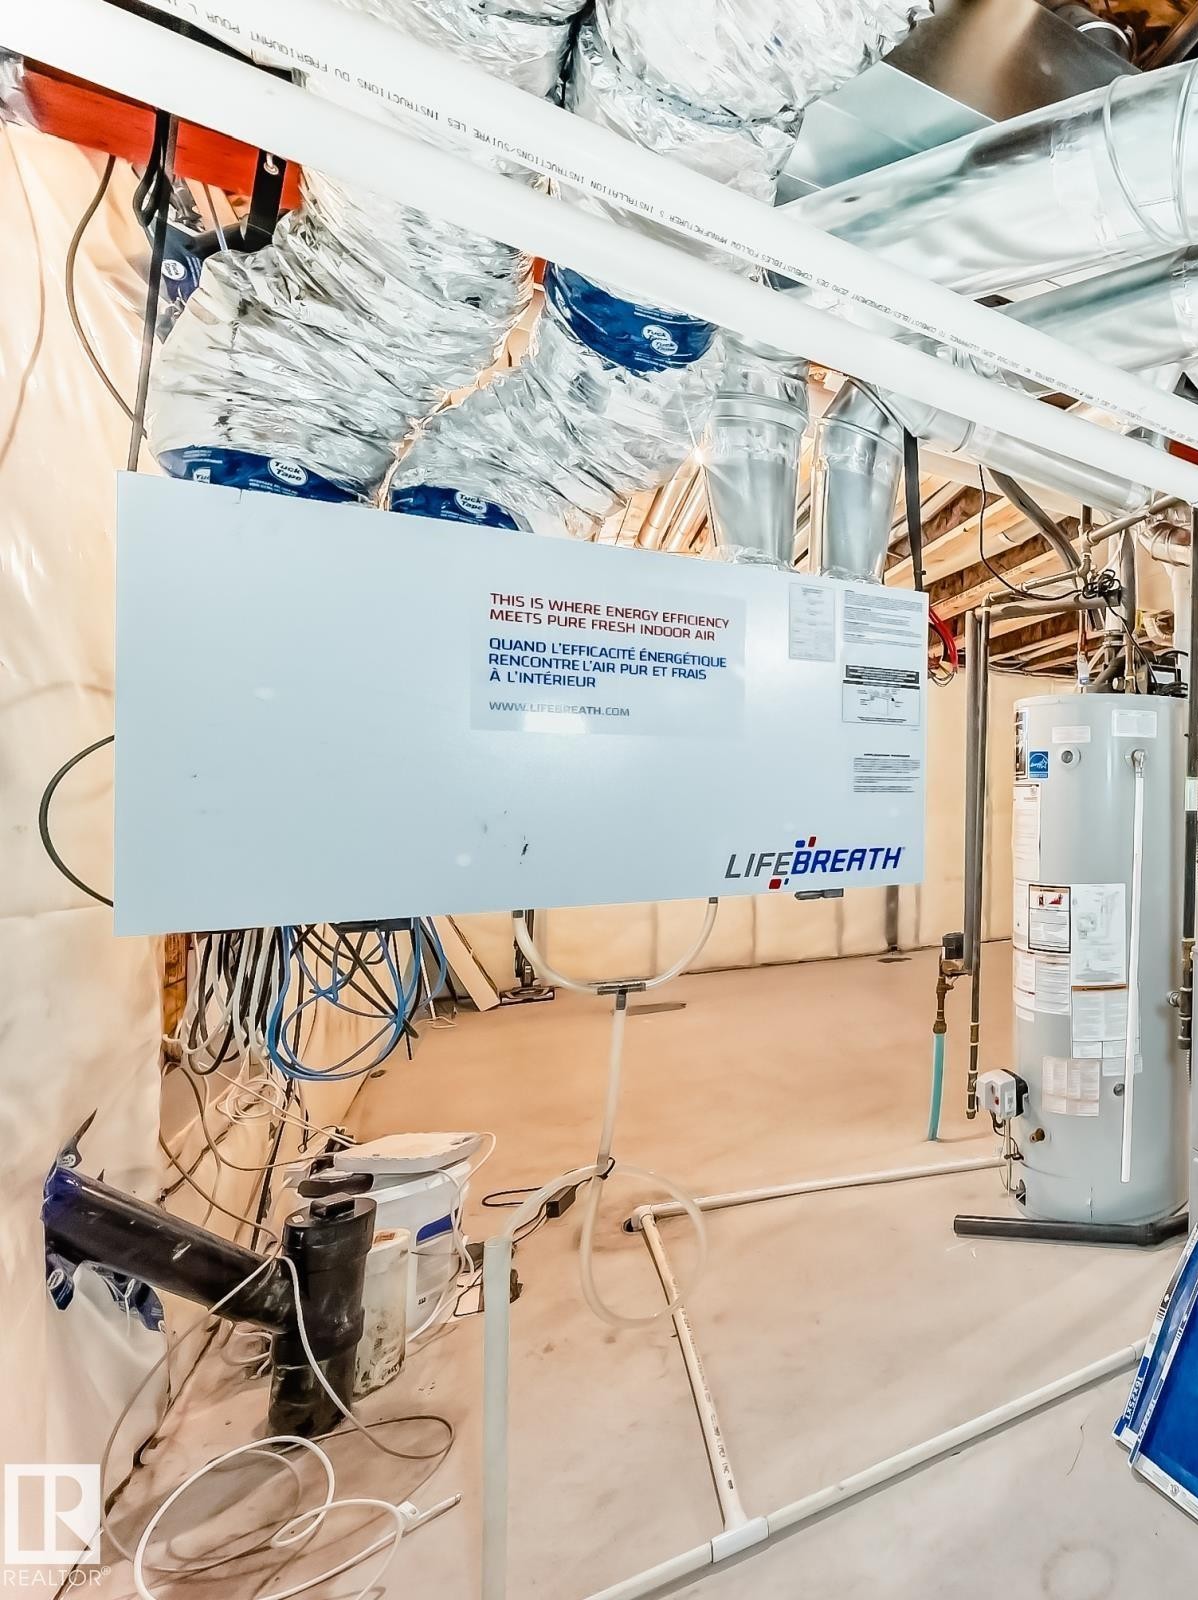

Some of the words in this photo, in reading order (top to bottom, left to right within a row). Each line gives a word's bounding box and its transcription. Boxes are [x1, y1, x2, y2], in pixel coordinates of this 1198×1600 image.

[206, 11, 240, 34] POUR
[250, 31, 328, 73] FABRIQUANT
[334, 68, 350, 82] DU
[356, 77, 439, 121] INSTRUCTIONS
[447, 117, 467, 132] LES
[590, 180, 654, 214] INSTALLATION
[274, 461, 302, 475] Tuck
[276, 468, 303, 482] Tape
[460, 494, 482, 504] Tuck
[461, 500, 484, 511] Tape
[490, 592, 525, 608] THIS
[530, 597, 544, 610] IS
[548, 599, 601, 616] WHERE
[606, 605, 660, 622] ENERGY
[662, 611, 729, 629] EFFICIENCY
[489, 609, 542, 625] MEETS
[547, 614, 587, 629] PURE
[591, 619, 636, 634] FRESH
[640, 624, 691, 639] INDOOR
[694, 629, 716, 641] AIR
[489, 637, 547, 653] QUAND
[551, 642, 636, 661] L'EFFICACITÉ
[639, 647, 727, 668] ÉNERGÉTIQUE
[488, 653, 580, 671] RENCONTRE
[582, 660, 616, 674] L'AIR
[620, 663, 648, 676] PUR
[652, 666, 667, 677] ET
[671, 668, 707, 680] FRAIS
[489, 667, 501, 682] À
[507, 669, 596, 688] L'INTÉRIEUR
[488, 701, 630, 717] WWW.LIFEBREATH.COM
[724, 847, 903, 879] LIFEBREATH
